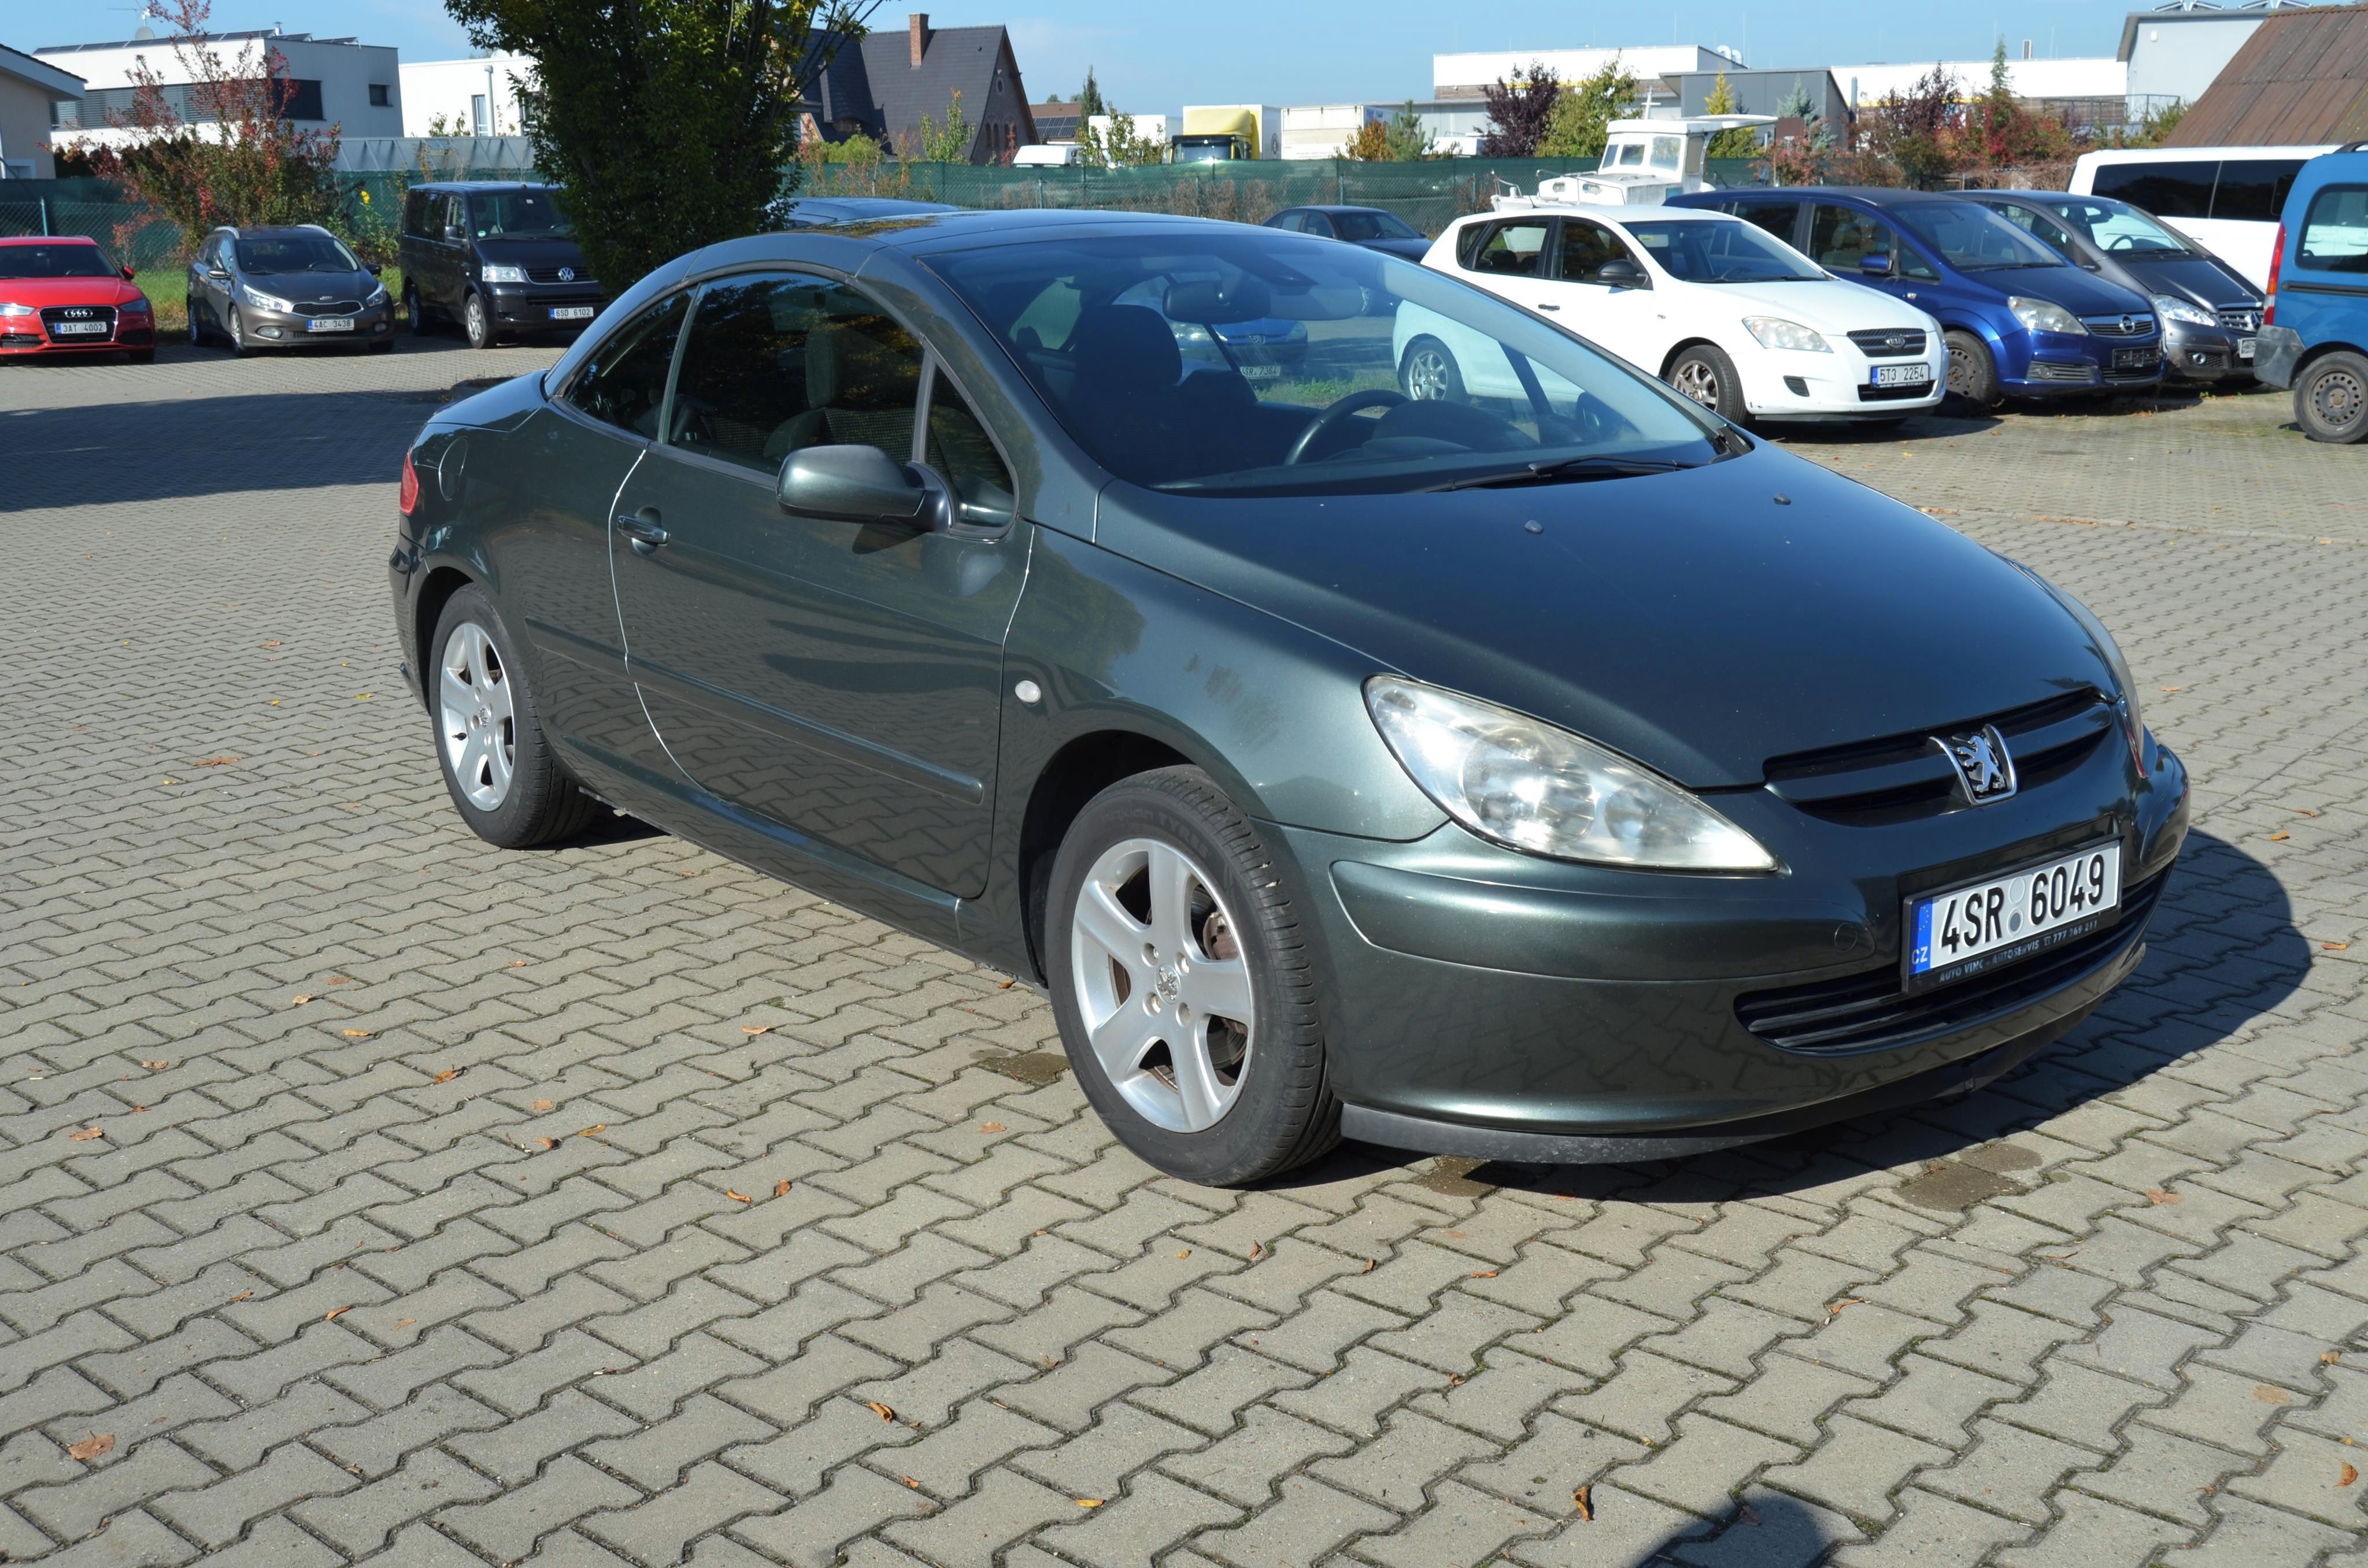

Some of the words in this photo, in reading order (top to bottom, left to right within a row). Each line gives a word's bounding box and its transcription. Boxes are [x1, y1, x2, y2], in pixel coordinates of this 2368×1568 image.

[63, 324, 77, 332] 3AT
[84, 324, 103, 332] 4002
[314, 321, 328, 329] 4AC
[333, 320, 351, 328] 3438
[1880, 368, 1897, 381] 5T3
[1904, 366, 1925, 380] 2254
[1941, 887, 2004, 954] 4SR
[2030, 853, 2105, 926] 6049
[1911, 946, 1929, 965] CZ
[1939, 969, 1962, 983] AUTO
[1992, 940, 2040, 964] AUTOSERVIS
[2053, 930, 2067, 944] 777
